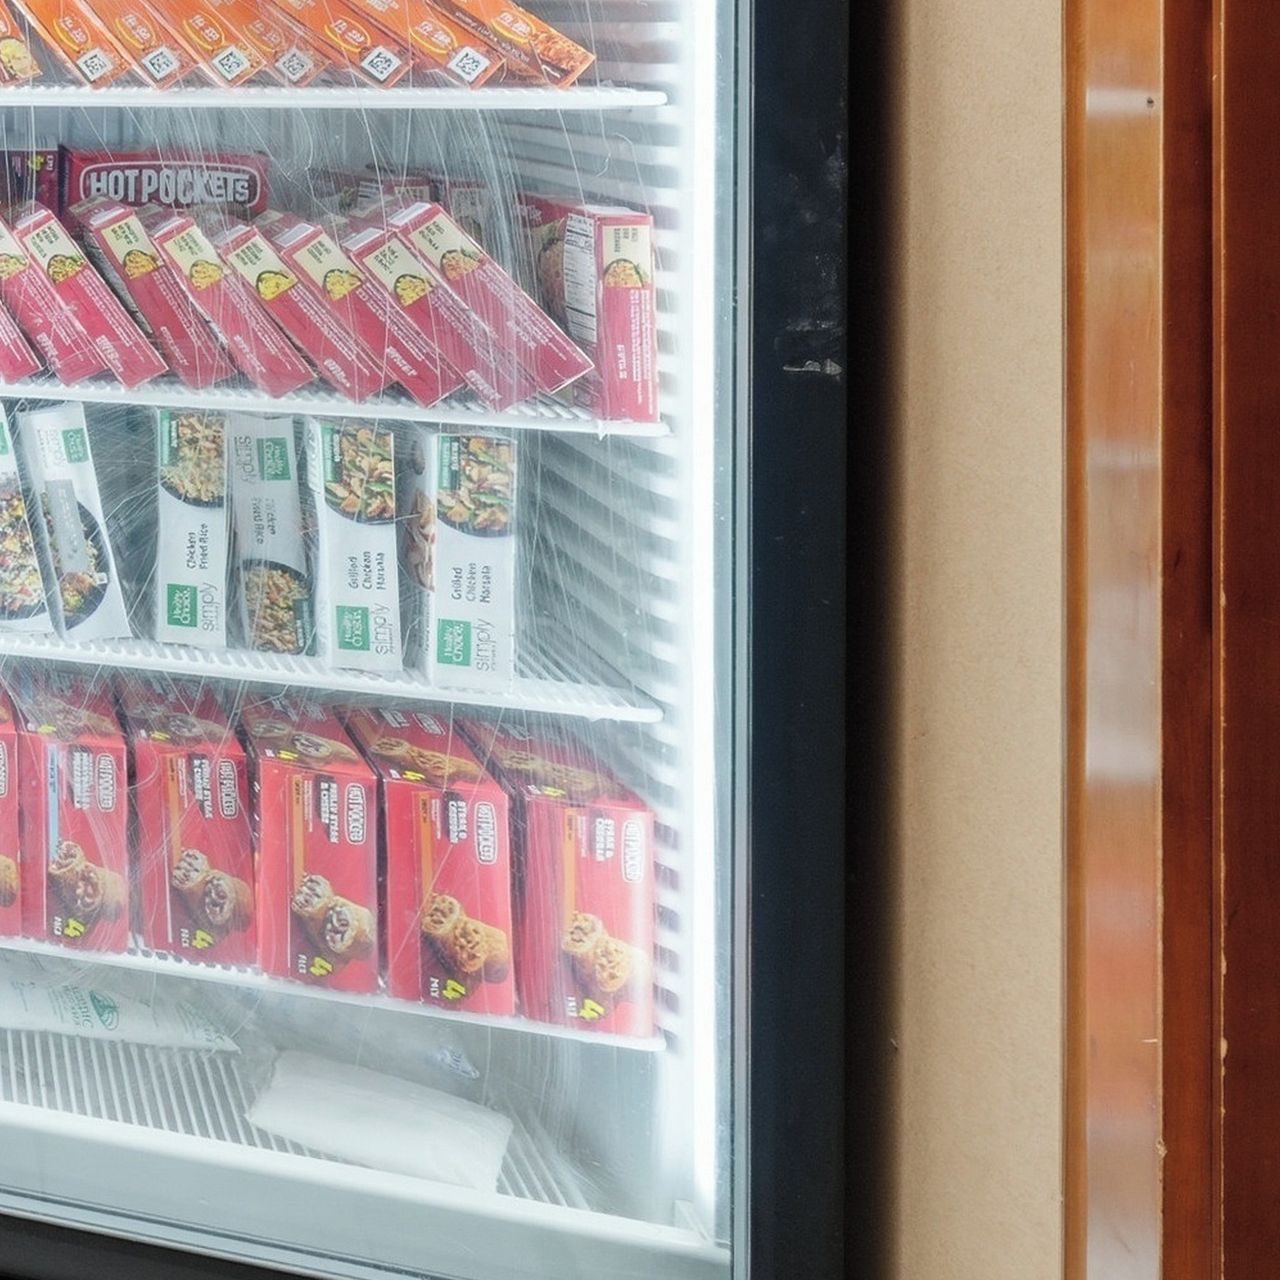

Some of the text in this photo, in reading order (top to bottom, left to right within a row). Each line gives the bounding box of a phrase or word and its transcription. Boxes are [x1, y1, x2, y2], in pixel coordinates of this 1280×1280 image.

[90, 168, 250, 204] HOT POCKETS
[198, 582, 217, 632] simply
[371, 603, 391, 656] simply
[475, 618, 492, 671] simply
